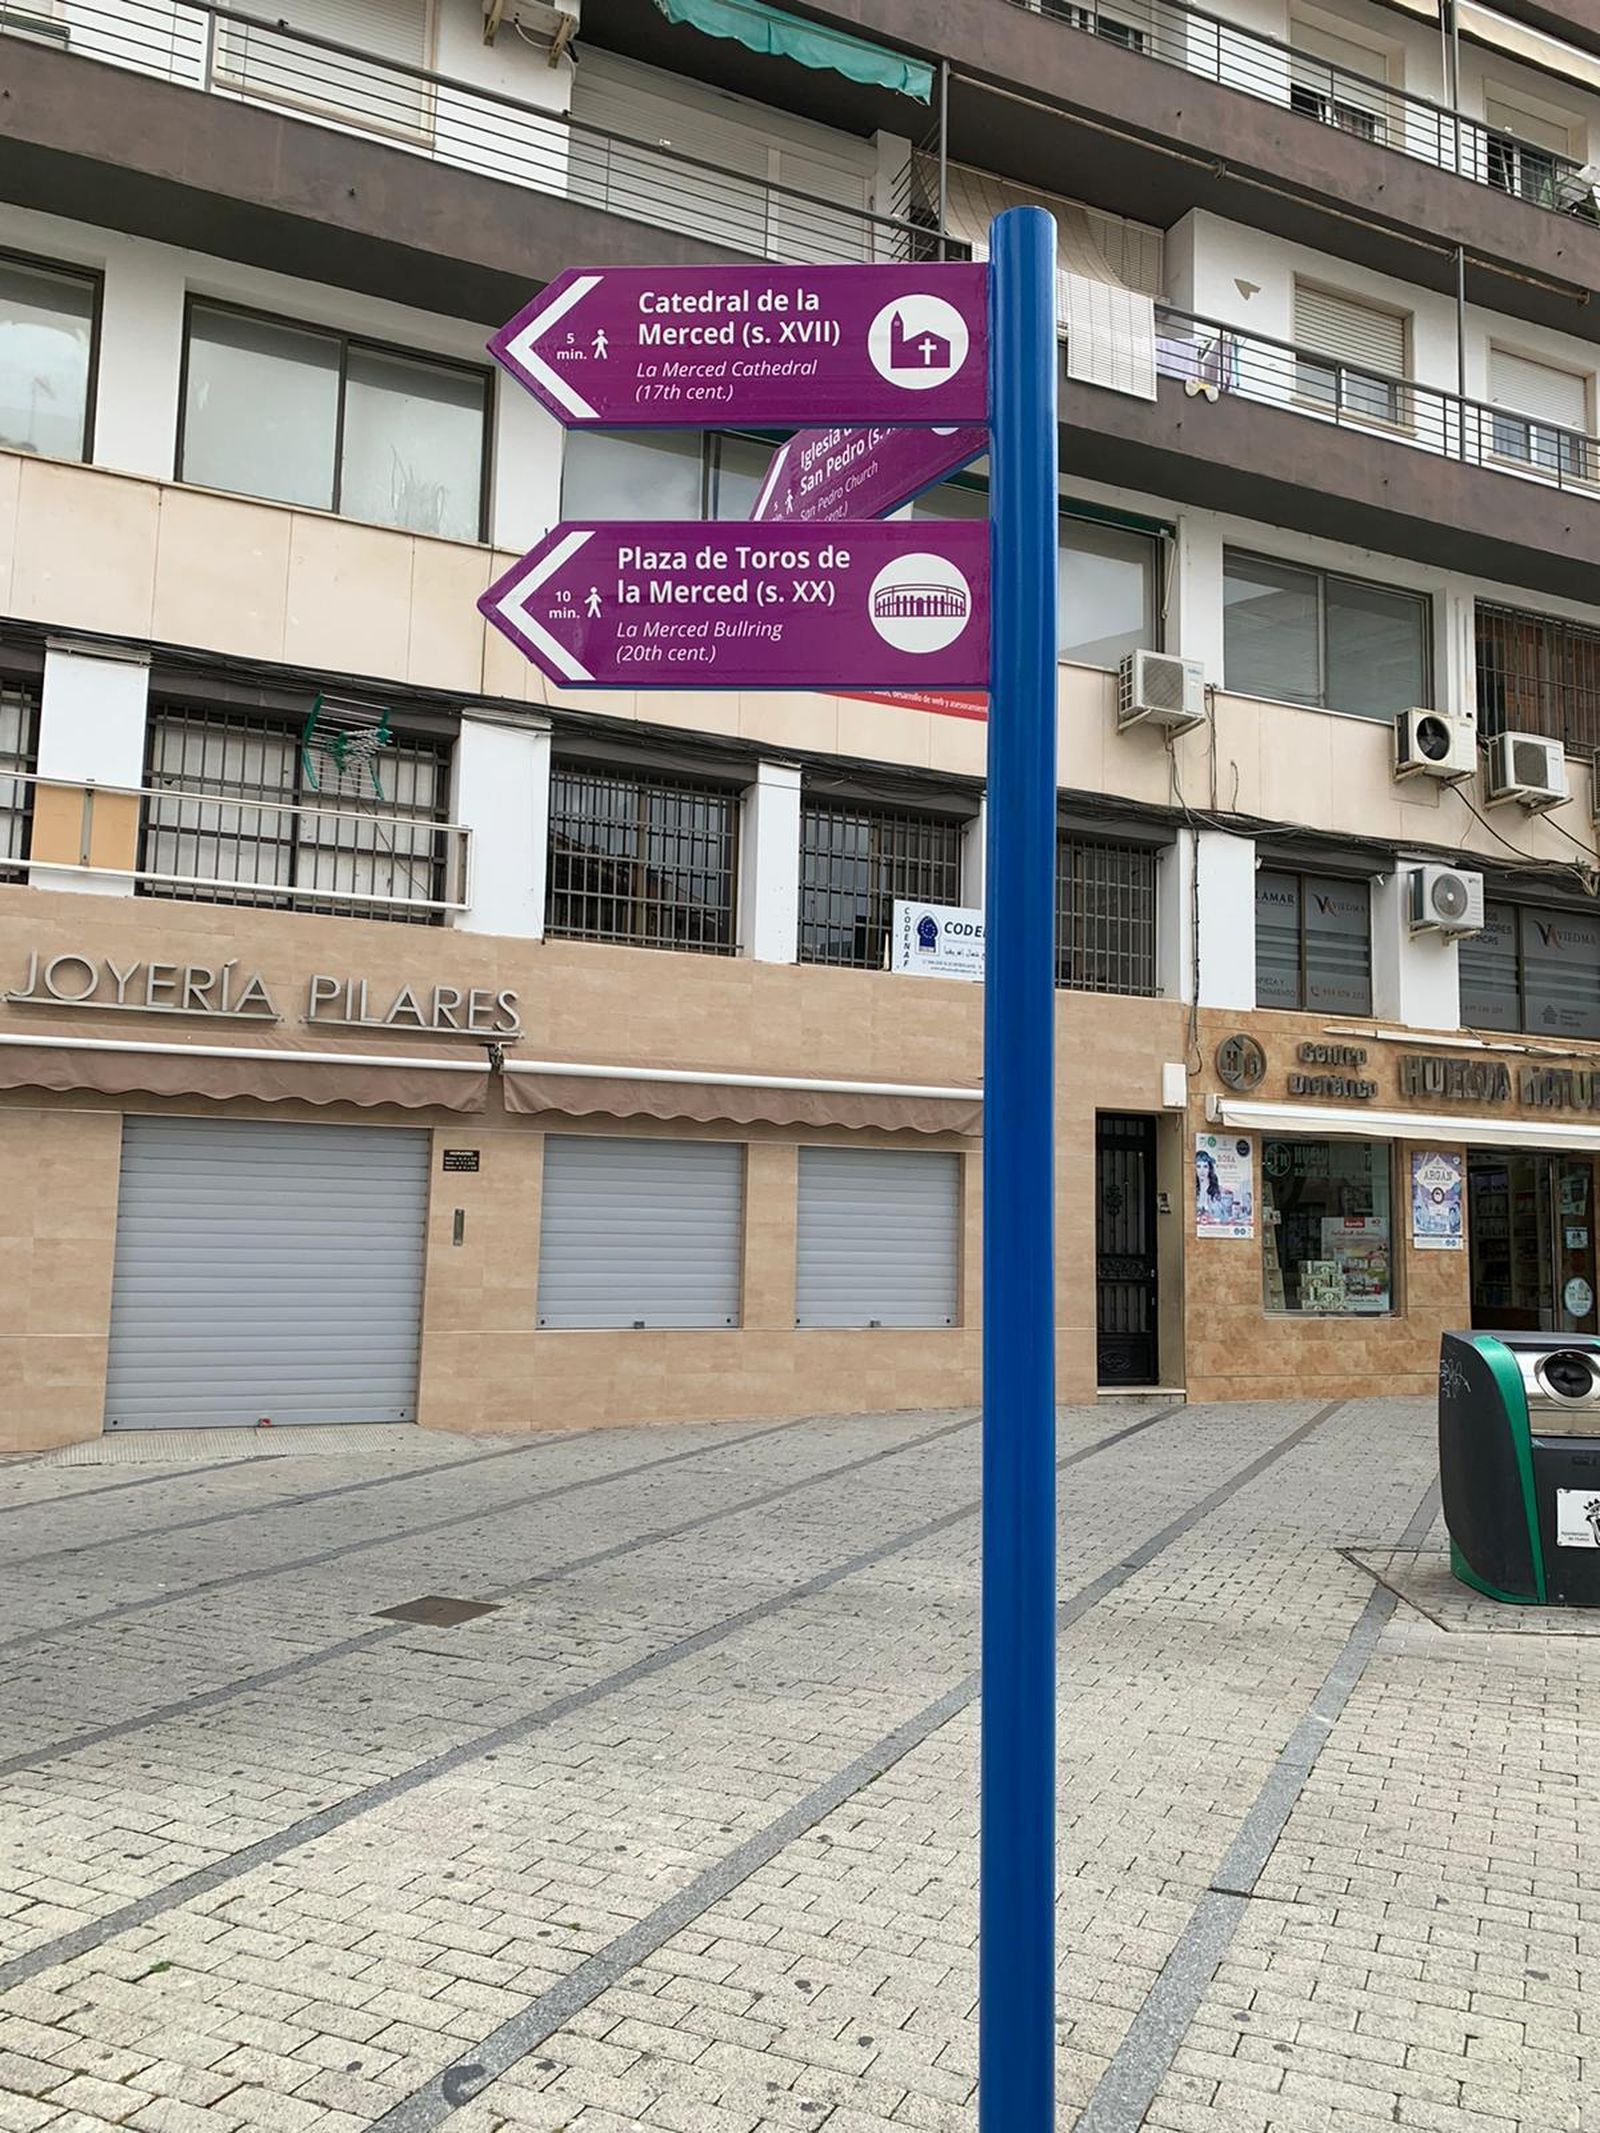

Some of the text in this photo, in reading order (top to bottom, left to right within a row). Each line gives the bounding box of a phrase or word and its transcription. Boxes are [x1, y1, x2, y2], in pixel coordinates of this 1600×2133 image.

[639, 289, 819, 314] Catedral de la
[566, 333, 575, 343] 5
[639, 320, 840, 348] Merced (s. XVII)
[556, 348, 587, 360] min.
[637, 360, 818, 377] La Merced Cathedral
[636, 384, 734, 402] (17th cent.)
[801, 428, 841, 471] Iglesia
[800, 472, 823, 496] San
[826, 438, 865, 477] Pedro
[817, 486, 843, 514] Pedro
[845, 460, 879, 494] Church
[618, 544, 850, 570] Plaza de Toros de
[555, 590, 572, 602] 10
[618, 580, 836, 606] la Merced (s. XX)
[549, 606, 580, 619] min.
[616, 621, 783, 641] La Merced Bullring
[616, 645, 716, 663] (20th cent.)
[944, 921, 985, 939] CODE
[9, 947, 520, 1032] JOYERÍA PILARES
[1399, 1054, 1600, 1110] HUELVA NATU
